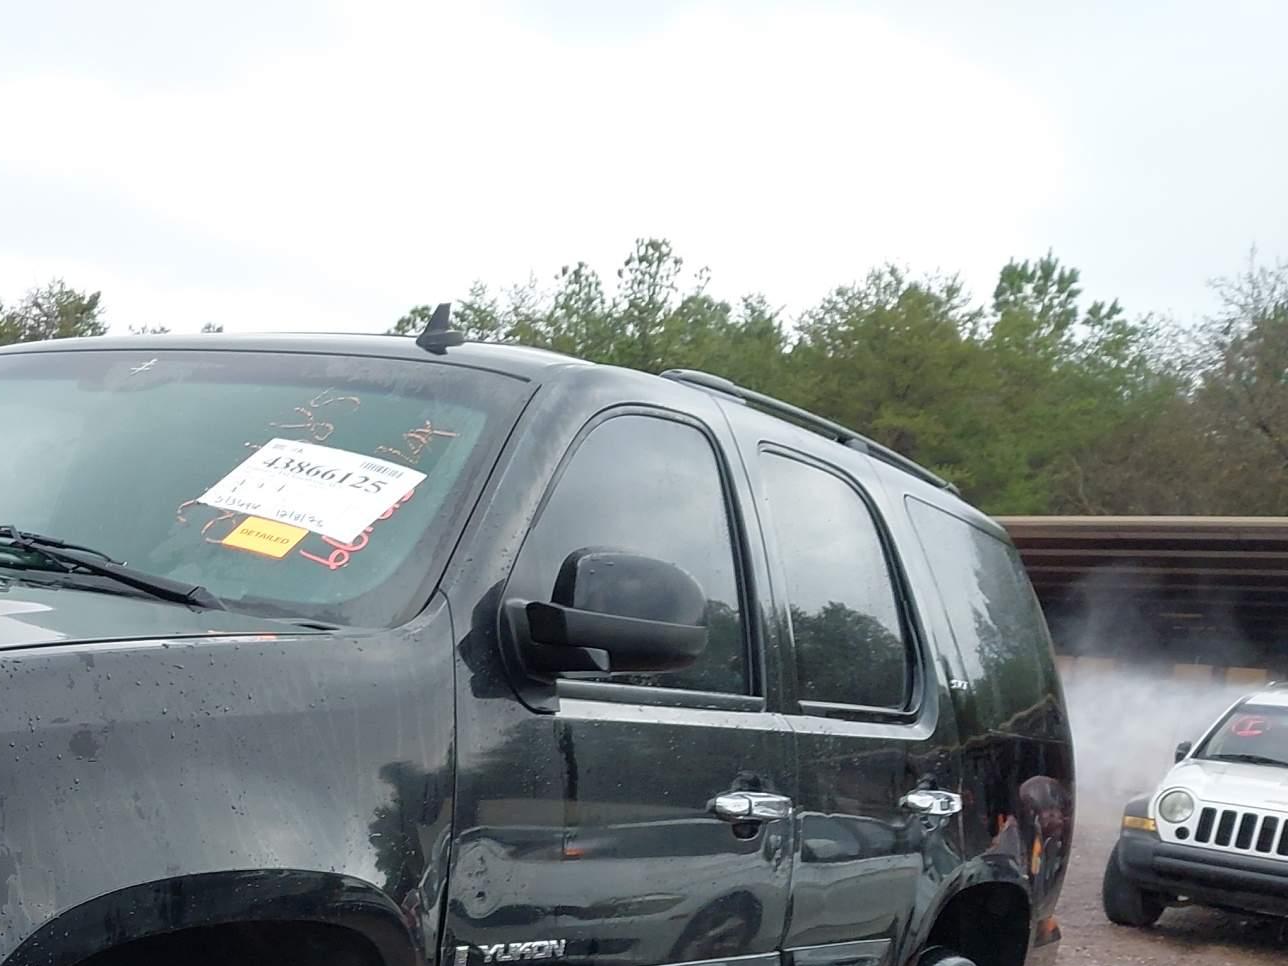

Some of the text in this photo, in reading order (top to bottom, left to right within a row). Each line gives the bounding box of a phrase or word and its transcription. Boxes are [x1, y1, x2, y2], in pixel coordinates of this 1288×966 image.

[263, 455, 388, 495] 43866125
[239, 528, 290, 545] DETAILED
[478, 939, 567, 963] YUKON
